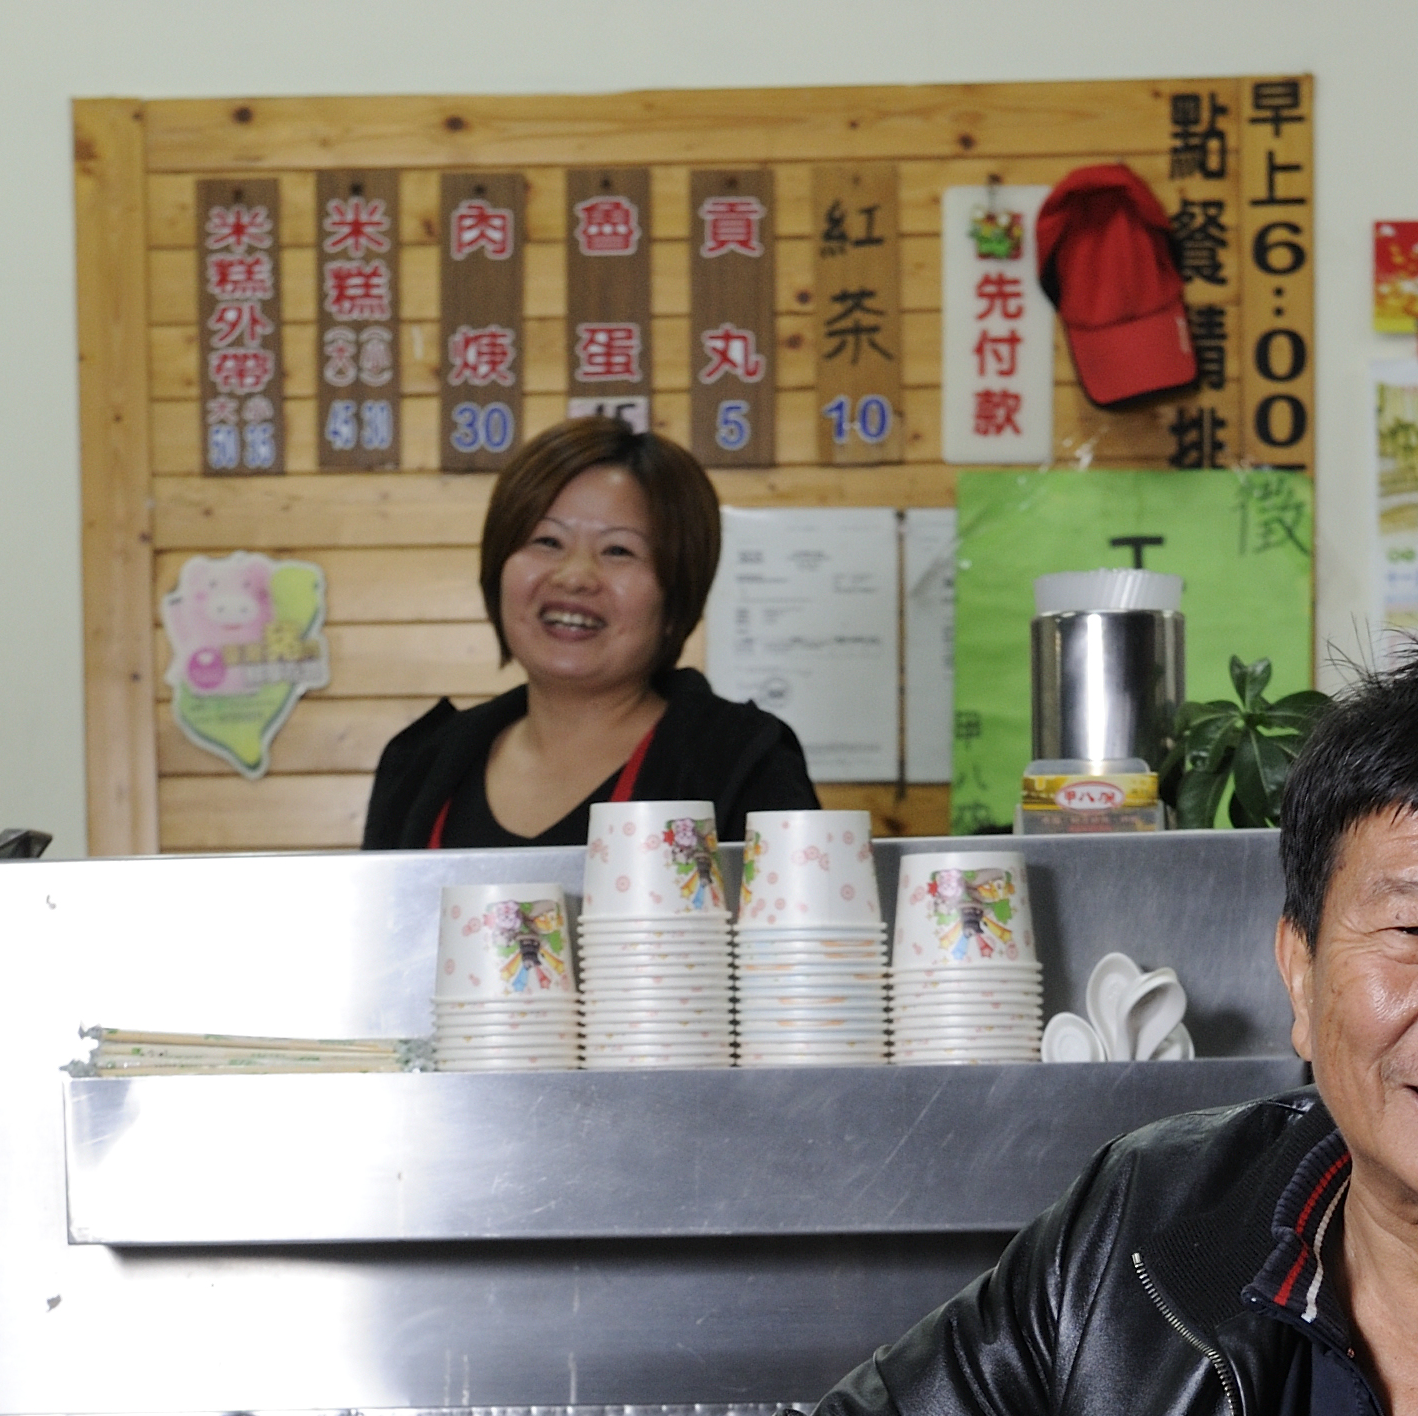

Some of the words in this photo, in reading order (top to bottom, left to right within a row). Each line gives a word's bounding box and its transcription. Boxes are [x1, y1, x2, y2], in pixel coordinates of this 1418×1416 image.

[205, 204, 275, 394] 米糕外帶
[323, 196, 392, 322] 米糕
[574, 196, 643, 382] 魯蛋
[698, 195, 766, 385] 貢丸
[819, 199, 895, 366] 紅茶
[972, 212, 1024, 437] 先付款
[1249, 82, 1308, 471] 早上6:00
[451, 401, 515, 453] 30
[716, 401, 750, 449] 5
[823, 394, 892, 443] 10
